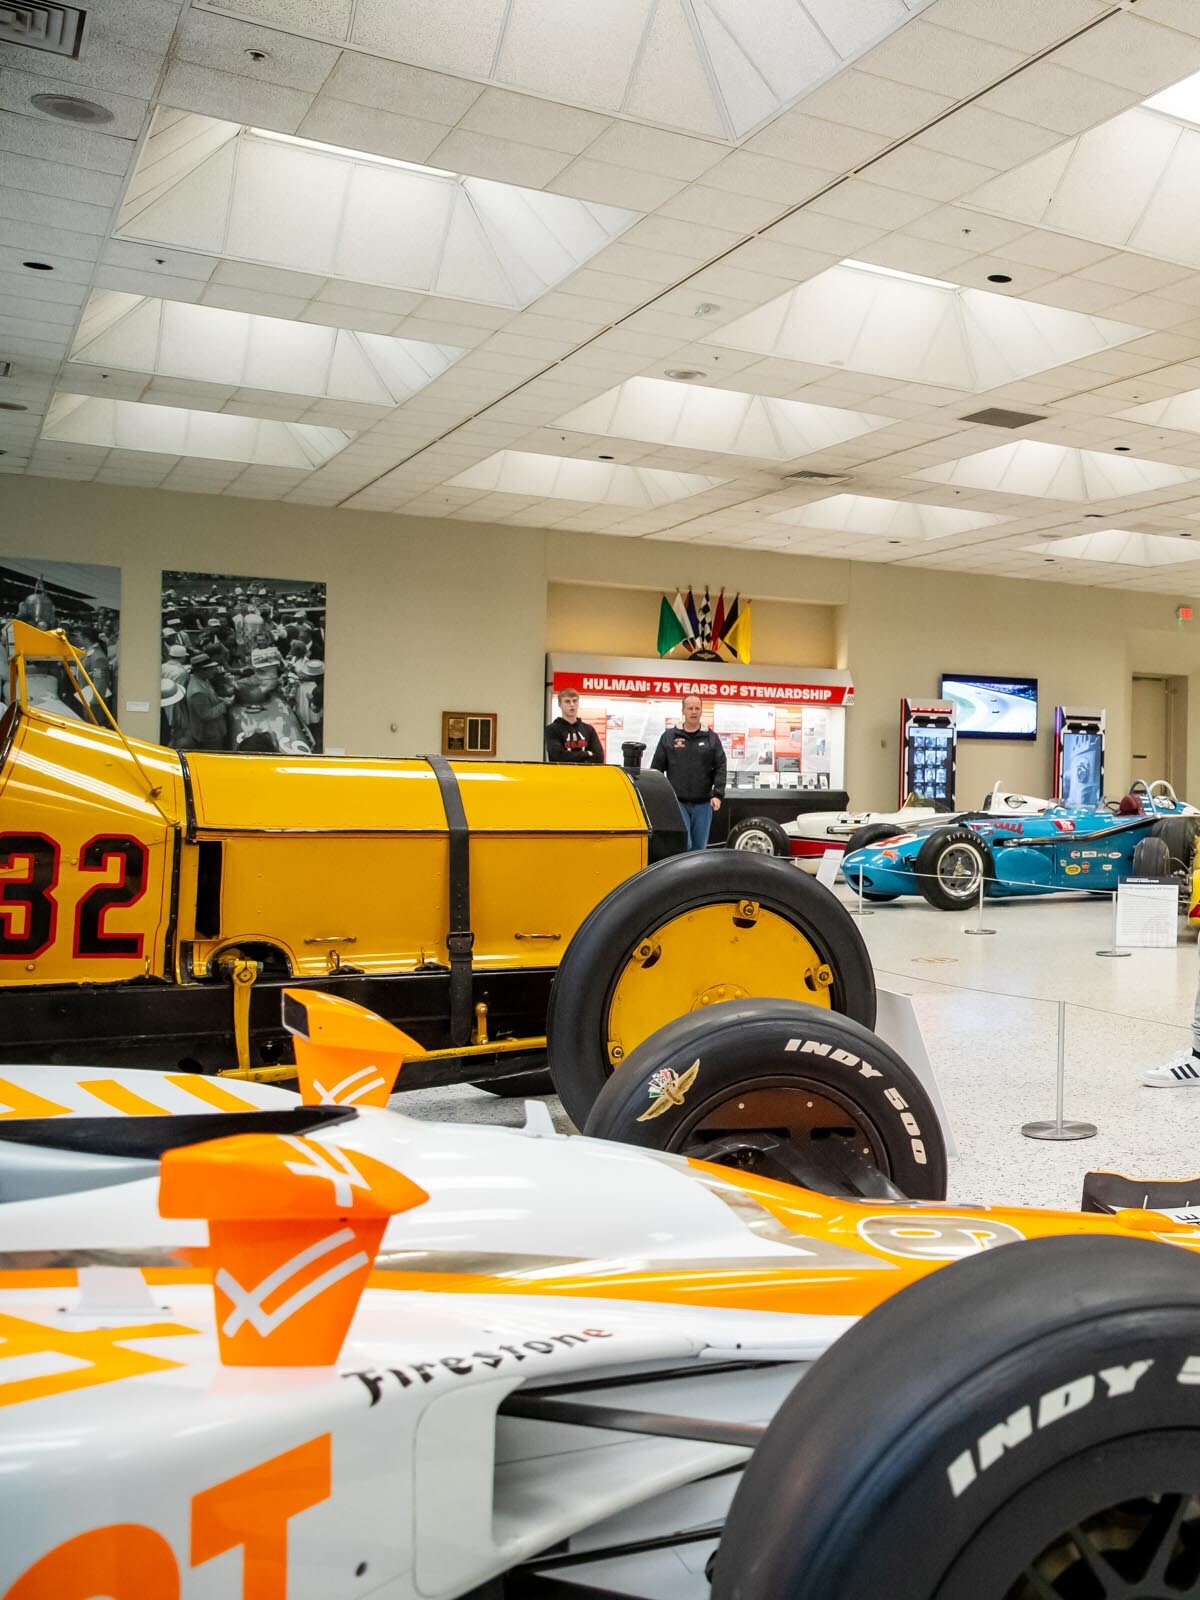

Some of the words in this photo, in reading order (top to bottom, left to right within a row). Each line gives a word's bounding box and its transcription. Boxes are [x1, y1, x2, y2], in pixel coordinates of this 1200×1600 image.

[583, 677, 650, 692] HULMAN:
[654, 681, 671, 693] 75
[673, 682, 718, 696] YEARS
[720, 684, 738, 696] OF
[740, 685, 832, 701] STEWARDSHIP
[0, 831, 149, 960] 32
[784, 1037, 885, 1079] INDY
[883, 1087, 928, 1166] 500
[340, 1326, 614, 1408] Firestone
[946, 1357, 1155, 1500] INDY
